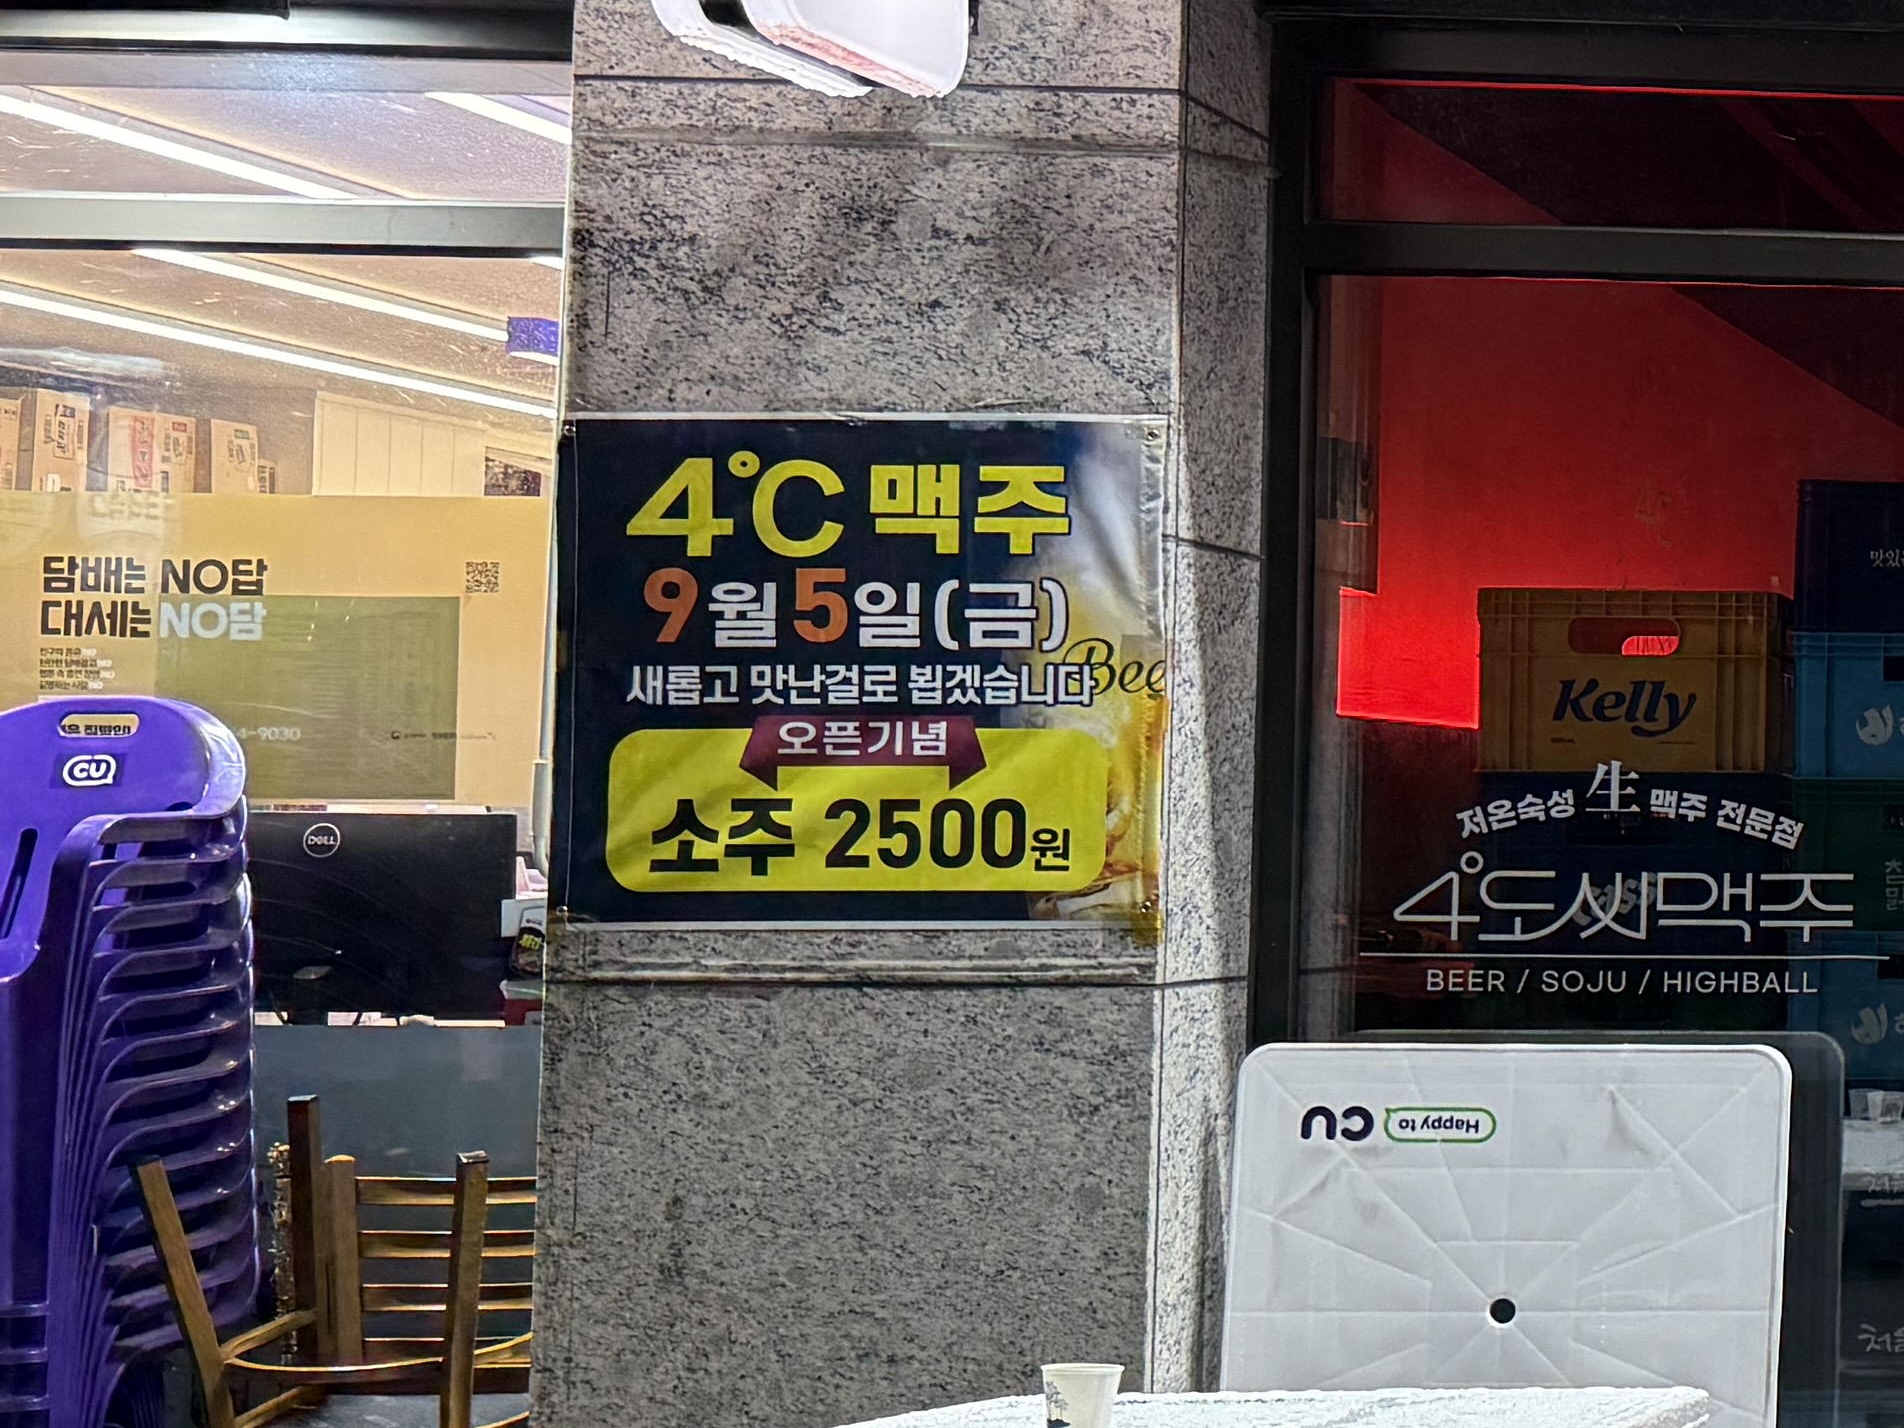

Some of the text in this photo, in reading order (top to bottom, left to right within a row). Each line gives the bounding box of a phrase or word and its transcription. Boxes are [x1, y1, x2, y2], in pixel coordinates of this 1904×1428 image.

[869, 463, 1070, 555] 맥주
[43, 556, 146, 594] 담배는
[41, 600, 151, 638] 대세는
[644, 567, 1070, 650] 9월 5일(금)
[625, 665, 738, 705] 새롭고
[751, 665, 897, 705] 맛난걸로
[1552, 678, 1697, 737] Kelly
[777, 721, 948, 758] 오픈기념
[73, 761, 106, 779] CU
[1455, 760, 1804, 851] 저온숙성 生 맥주 전문점
[308, 835, 337, 846] DELL
[649, 798, 1071, 875] 소주 2500원
[1426, 969, 1505, 994] BEER
[1541, 969, 1627, 994] SOJU
[1663, 969, 1818, 994] HIGHBALL
[1300, 1105, 1480, 1141] Happy to CU
